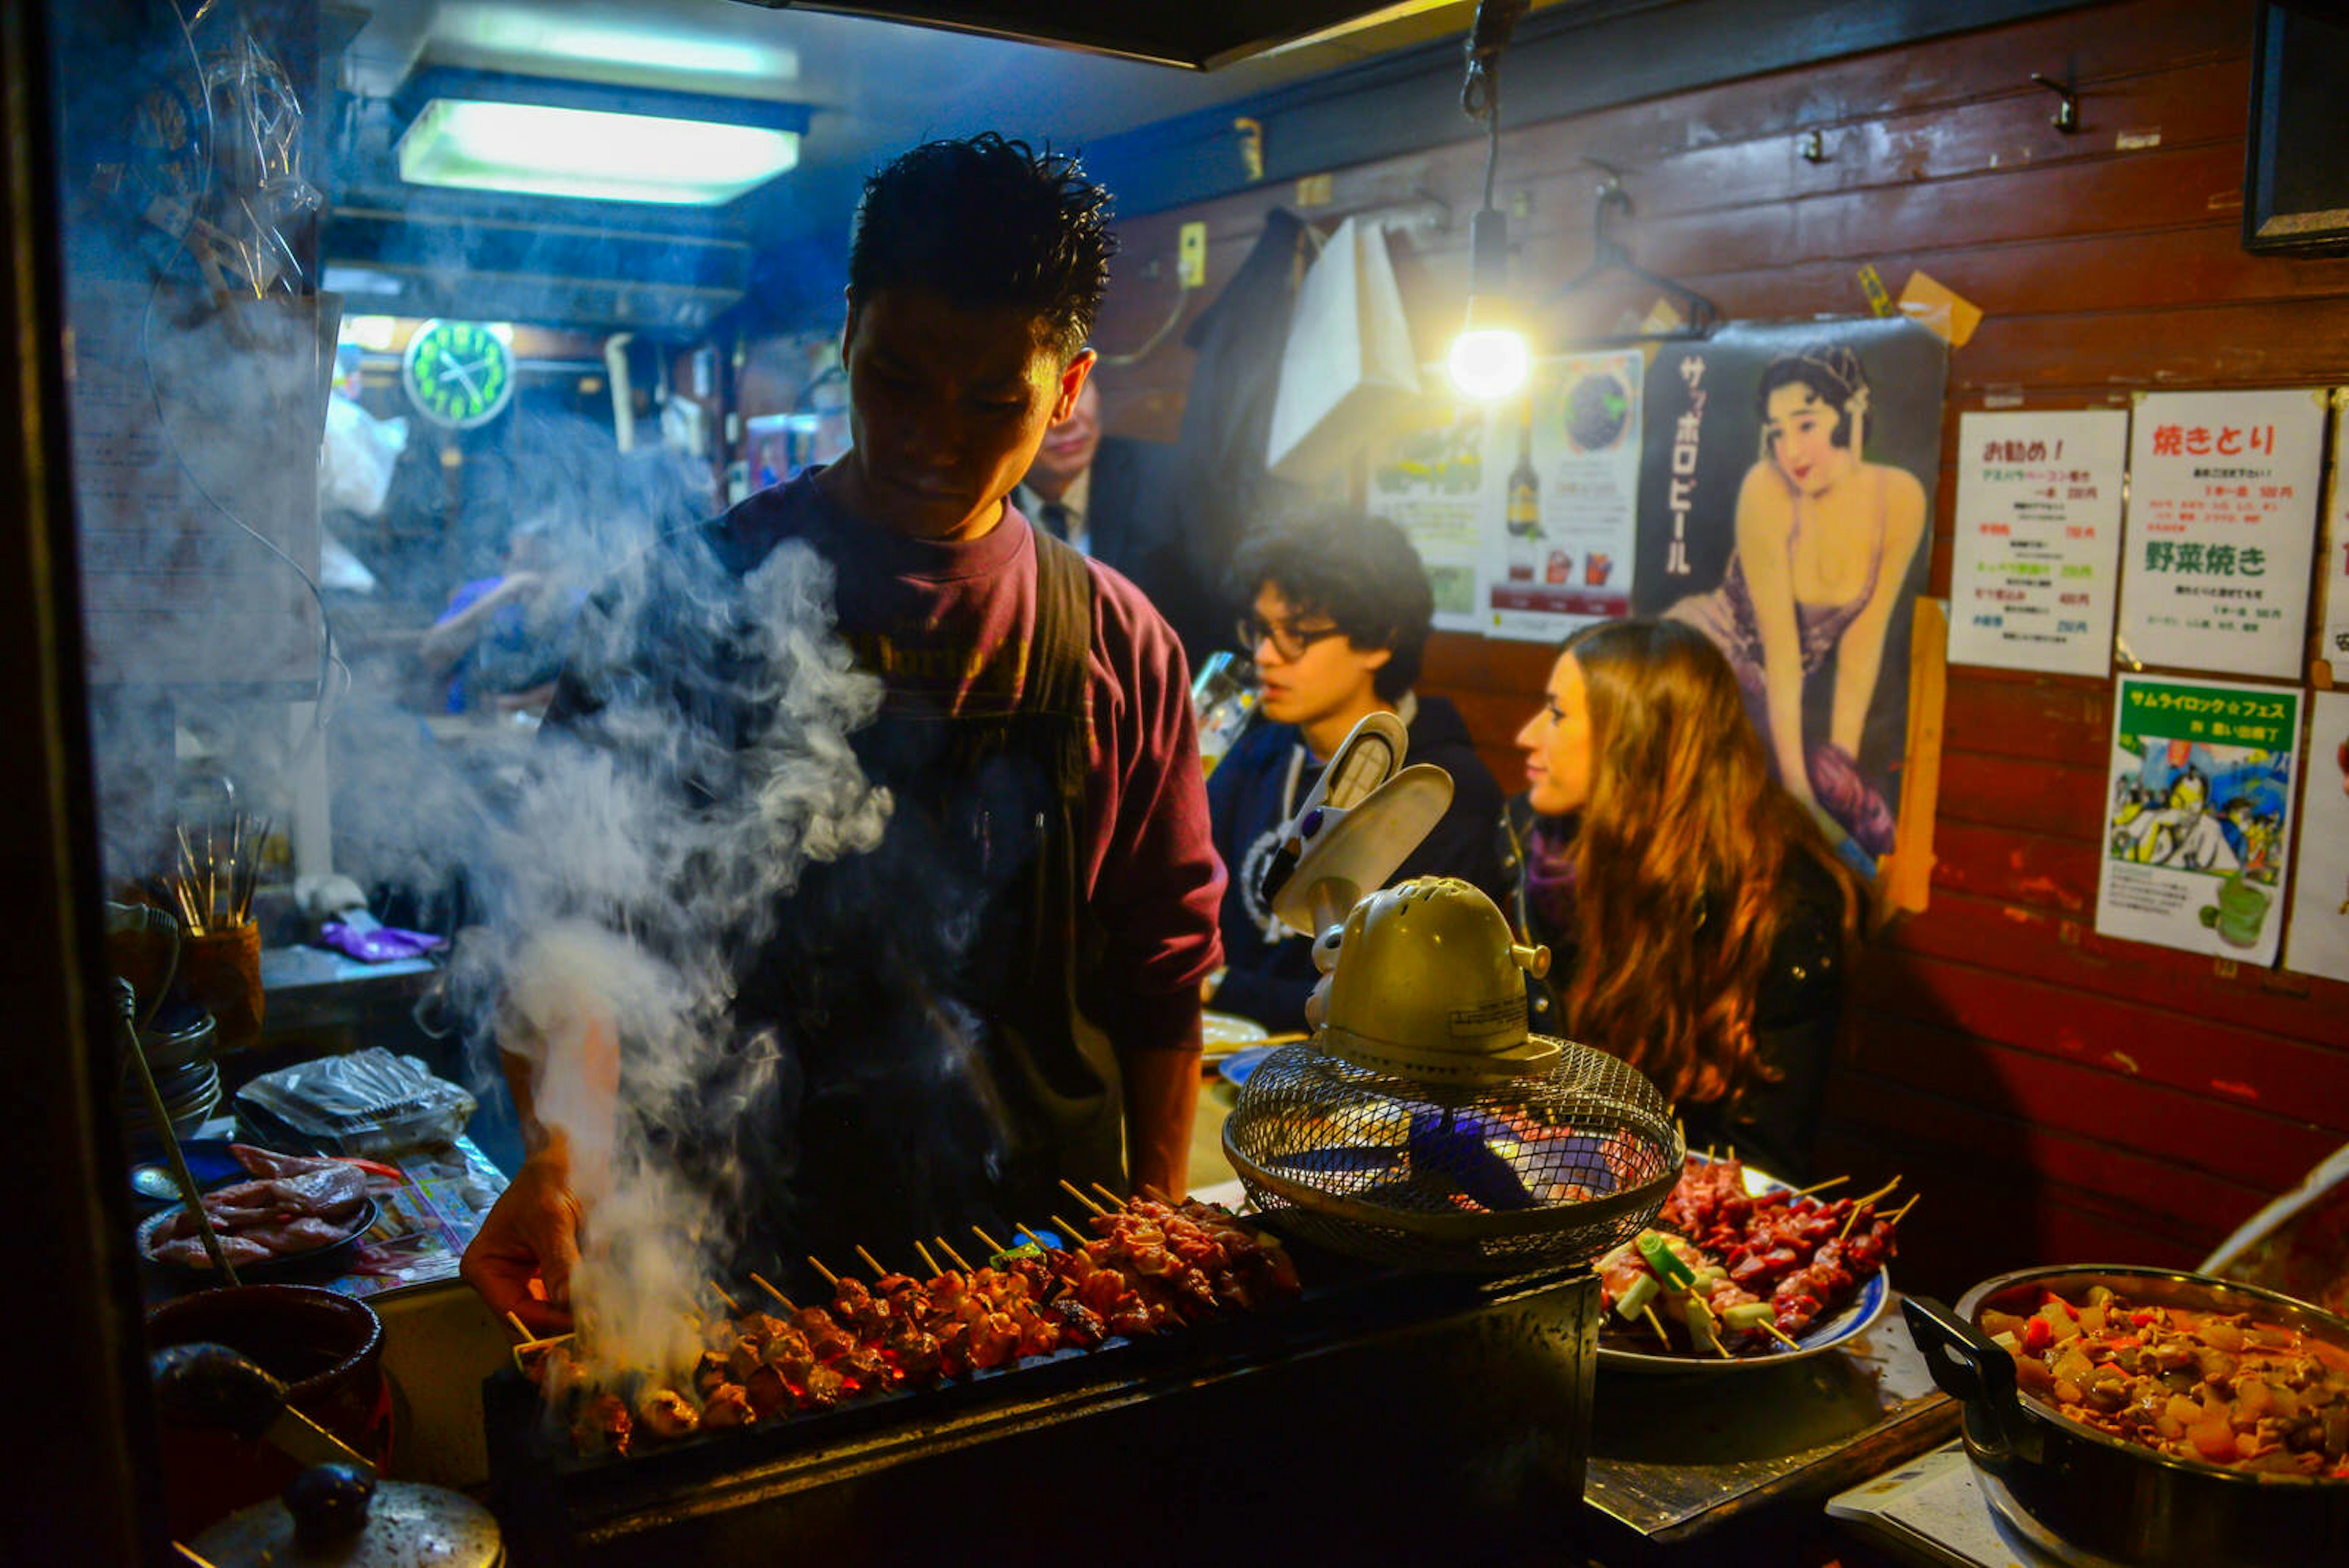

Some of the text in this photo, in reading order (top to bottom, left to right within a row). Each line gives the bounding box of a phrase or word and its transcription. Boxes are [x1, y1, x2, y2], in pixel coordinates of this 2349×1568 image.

[2152, 423, 2274, 456] 焼きとり
[1666, 355, 1707, 575] サッポロビール
[2144, 540, 2266, 578] 野菜焼き
